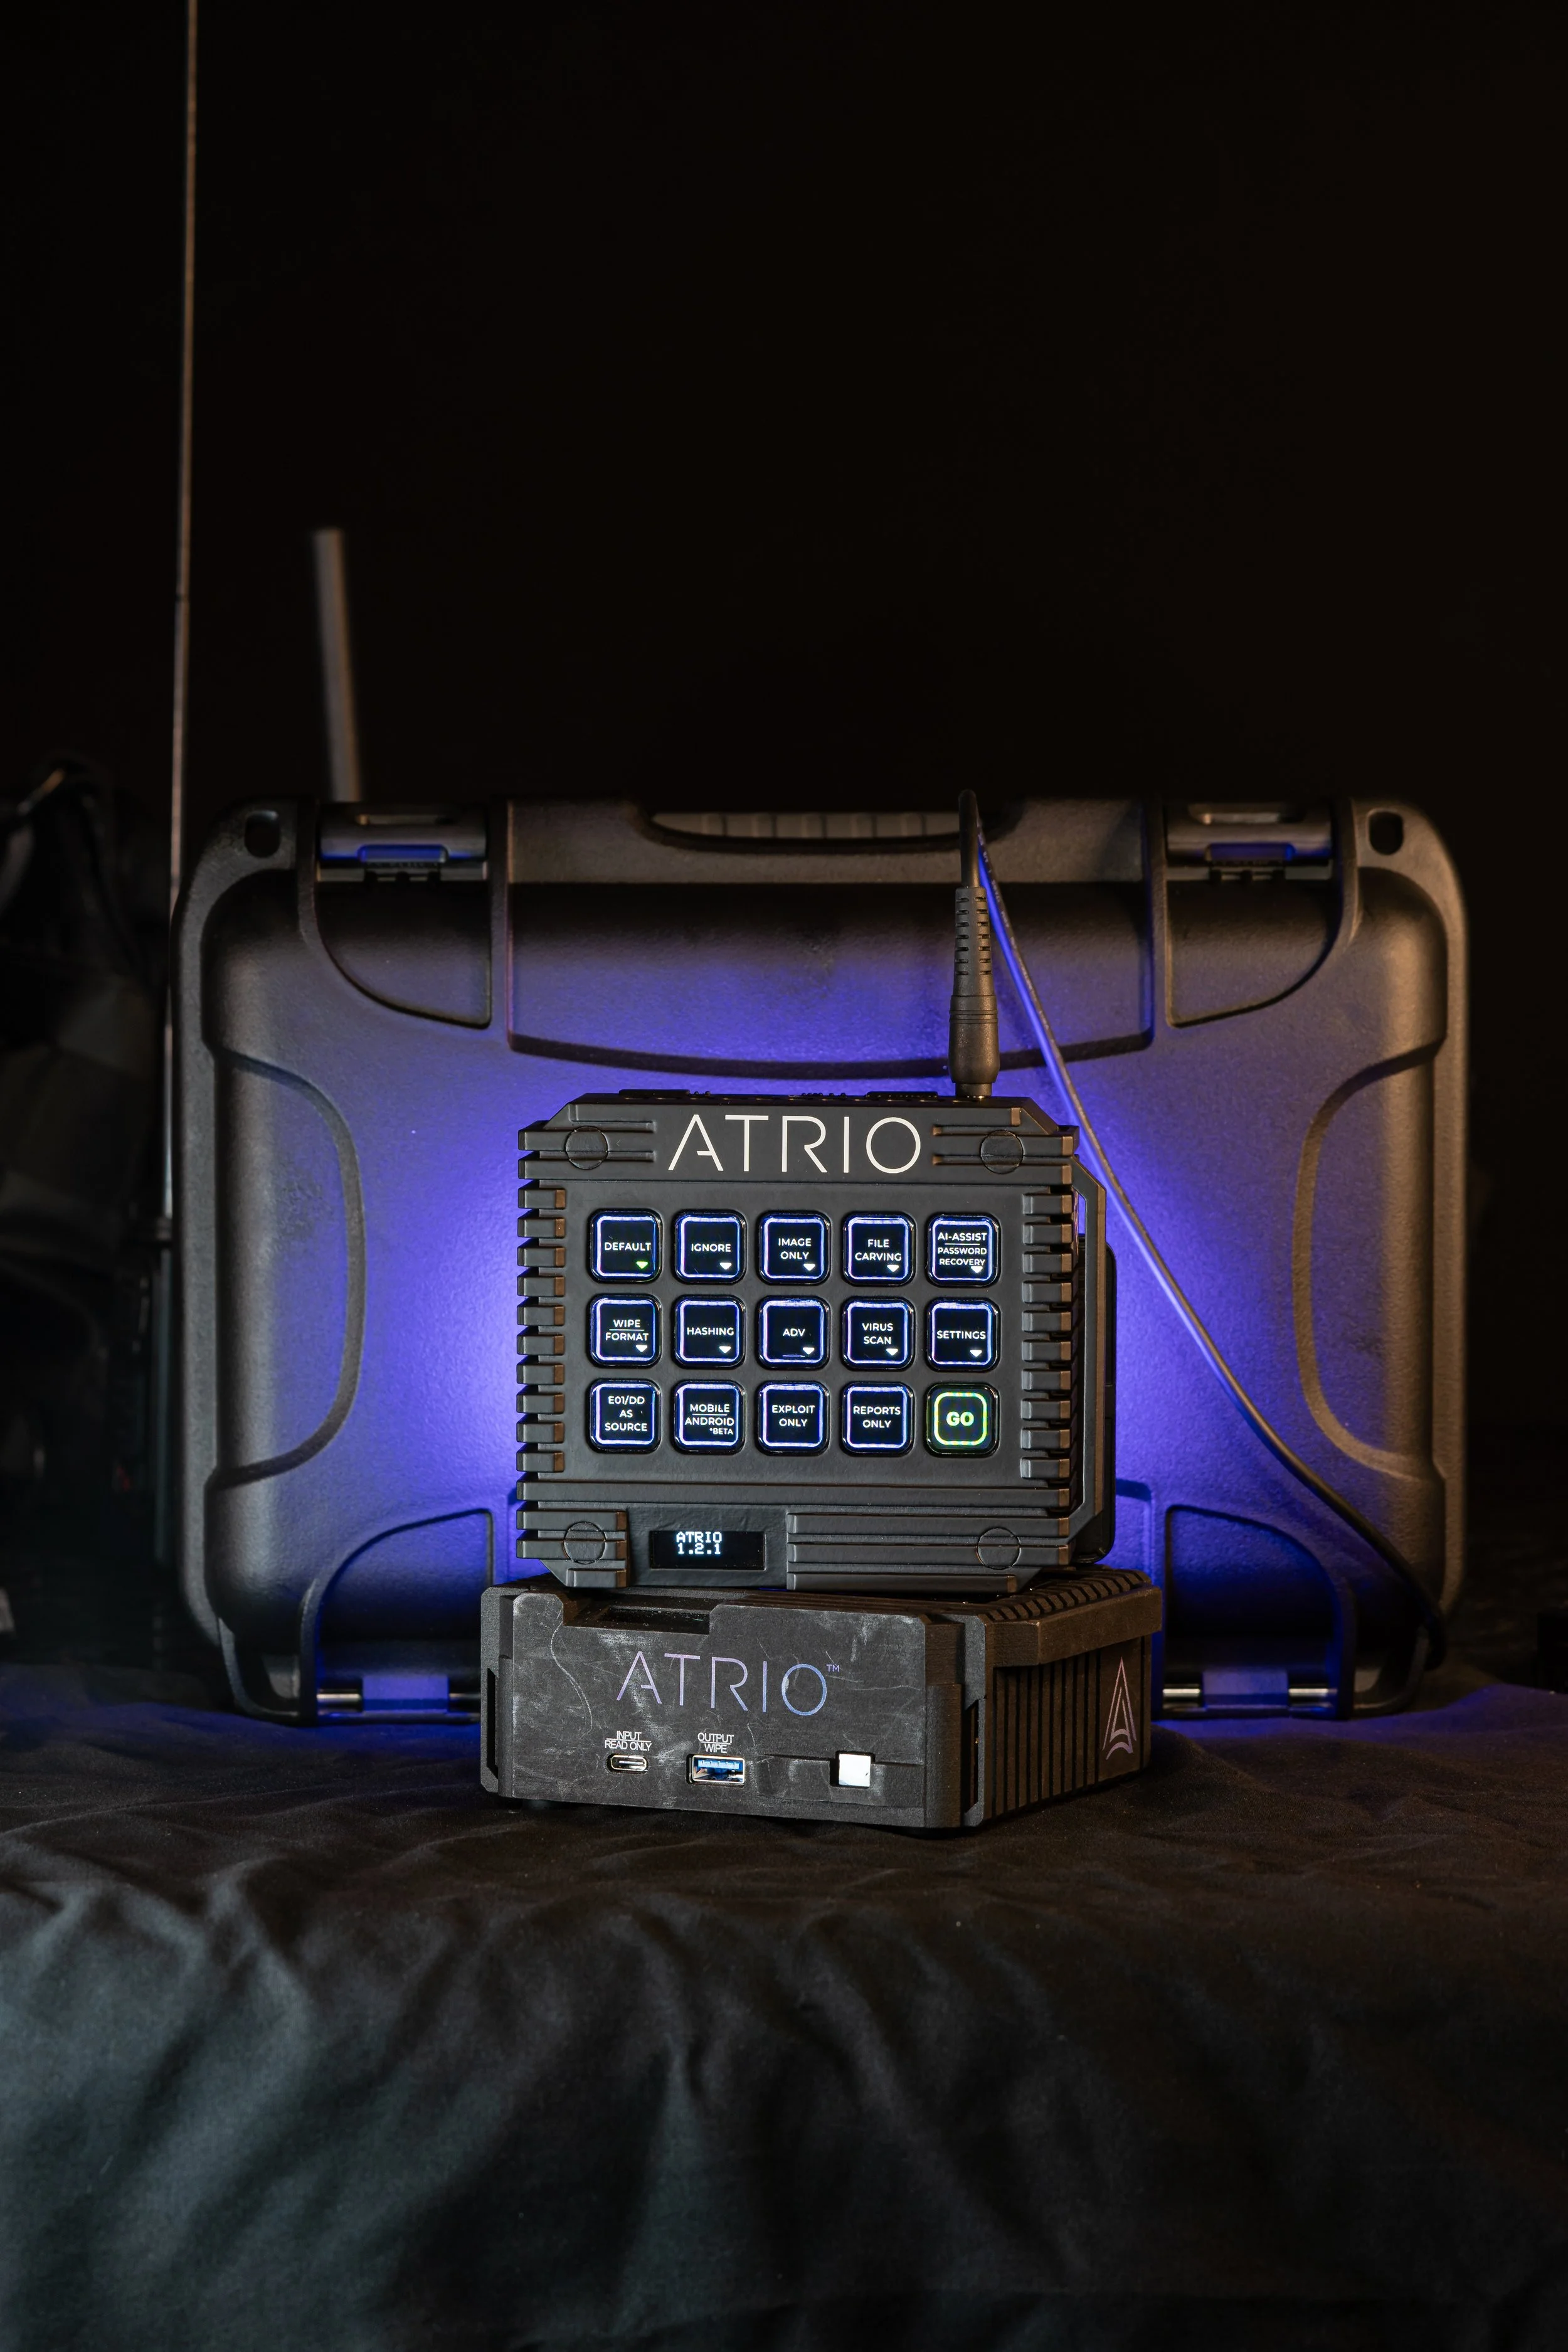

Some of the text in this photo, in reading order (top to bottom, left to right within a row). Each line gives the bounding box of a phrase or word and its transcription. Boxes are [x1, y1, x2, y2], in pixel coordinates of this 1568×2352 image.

[669, 1114, 921, 1174] ATRIO
[938, 1232, 987, 1241] AI-ASSIST
[604, 1242, 652, 1251] DEFAULT
[778, 1238, 812, 1247] IMAGE
[867, 1239, 889, 1248] FILE
[691, 1243, 731, 1252] IGNORE
[780, 1251, 809, 1260] ONLY
[855, 1253, 901, 1261] CARVING
[613, 1320, 641, 1328] WIPE
[862, 1323, 893, 1332] VIRUS
[687, 1327, 734, 1336] HASHING
[783, 1328, 805, 1337] ADV
[937, 1331, 986, 1340] SETTINGS
[605, 1333, 649, 1341] FORMAT
[864, 1337, 891, 1345] SCAN
[608, 1396, 645, 1405] E01/DD
[690, 1404, 729, 1412] MOBILE
[772, 1405, 815, 1414] EXPLOIT
[853, 1406, 901, 1415] REPORTS
[685, 1417, 734, 1426] ANDROID
[779, 1419, 807, 1428] ONLY
[946, 1412, 974, 1426] GO
[605, 1422, 647, 1432] SOURCE
[863, 1420, 891, 1428] ONLY
[675, 1531, 723, 1543] ATRIO
[677, 1542, 721, 1554] 1.2.1
[617, 1651, 827, 1716] ATRIO
[616, 1730, 642, 1741] INPUT
[697, 1732, 734, 1744] OUTPUT
[605, 1740, 652, 1751] READ ONLY
[704, 1742, 728, 1754] WIPE
